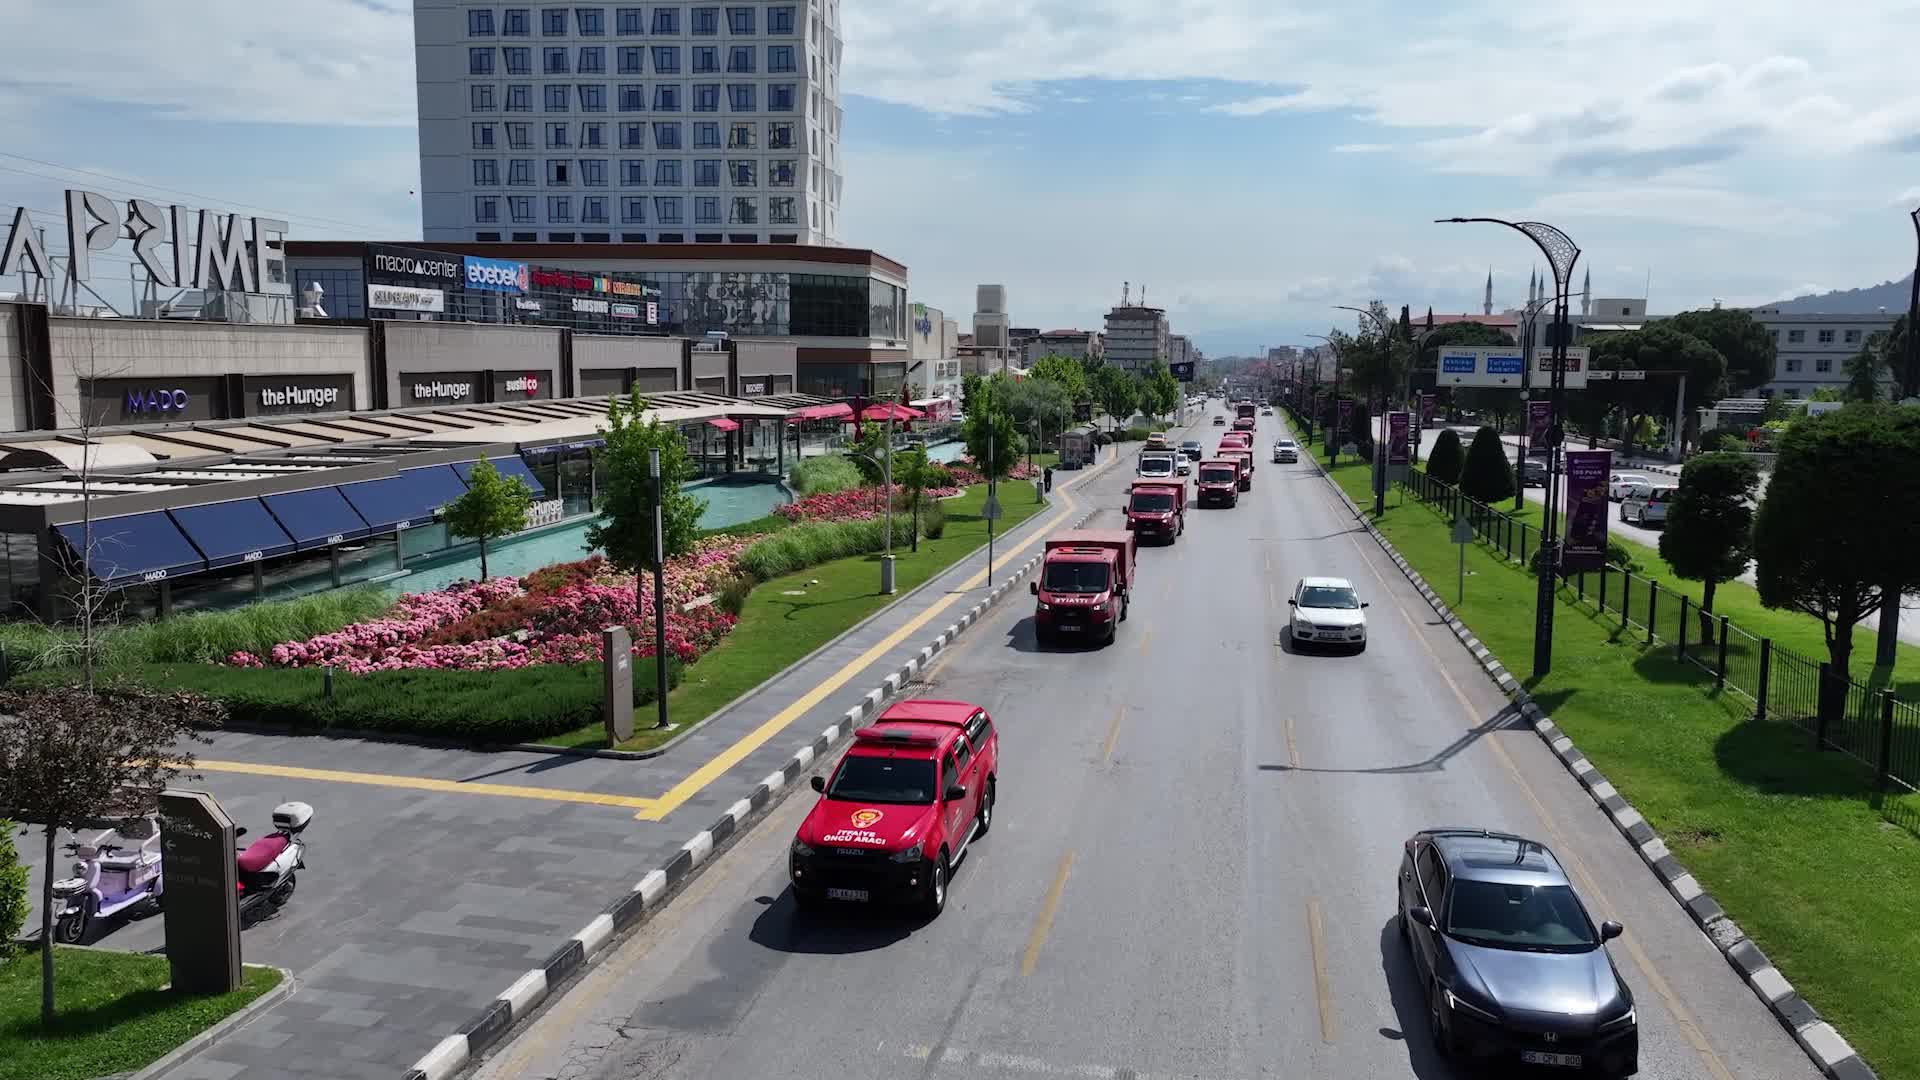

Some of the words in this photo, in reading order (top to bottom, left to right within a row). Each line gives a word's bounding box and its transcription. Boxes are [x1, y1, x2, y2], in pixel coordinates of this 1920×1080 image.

[65, 190, 292, 294] PRIME
[468, 262, 518, 286] ebebek
[572, 298, 609, 313] SAMSUNG
[127, 389, 190, 412] MADO
[244, 551, 263, 561] MADO
[144, 570, 167, 581] MADO
